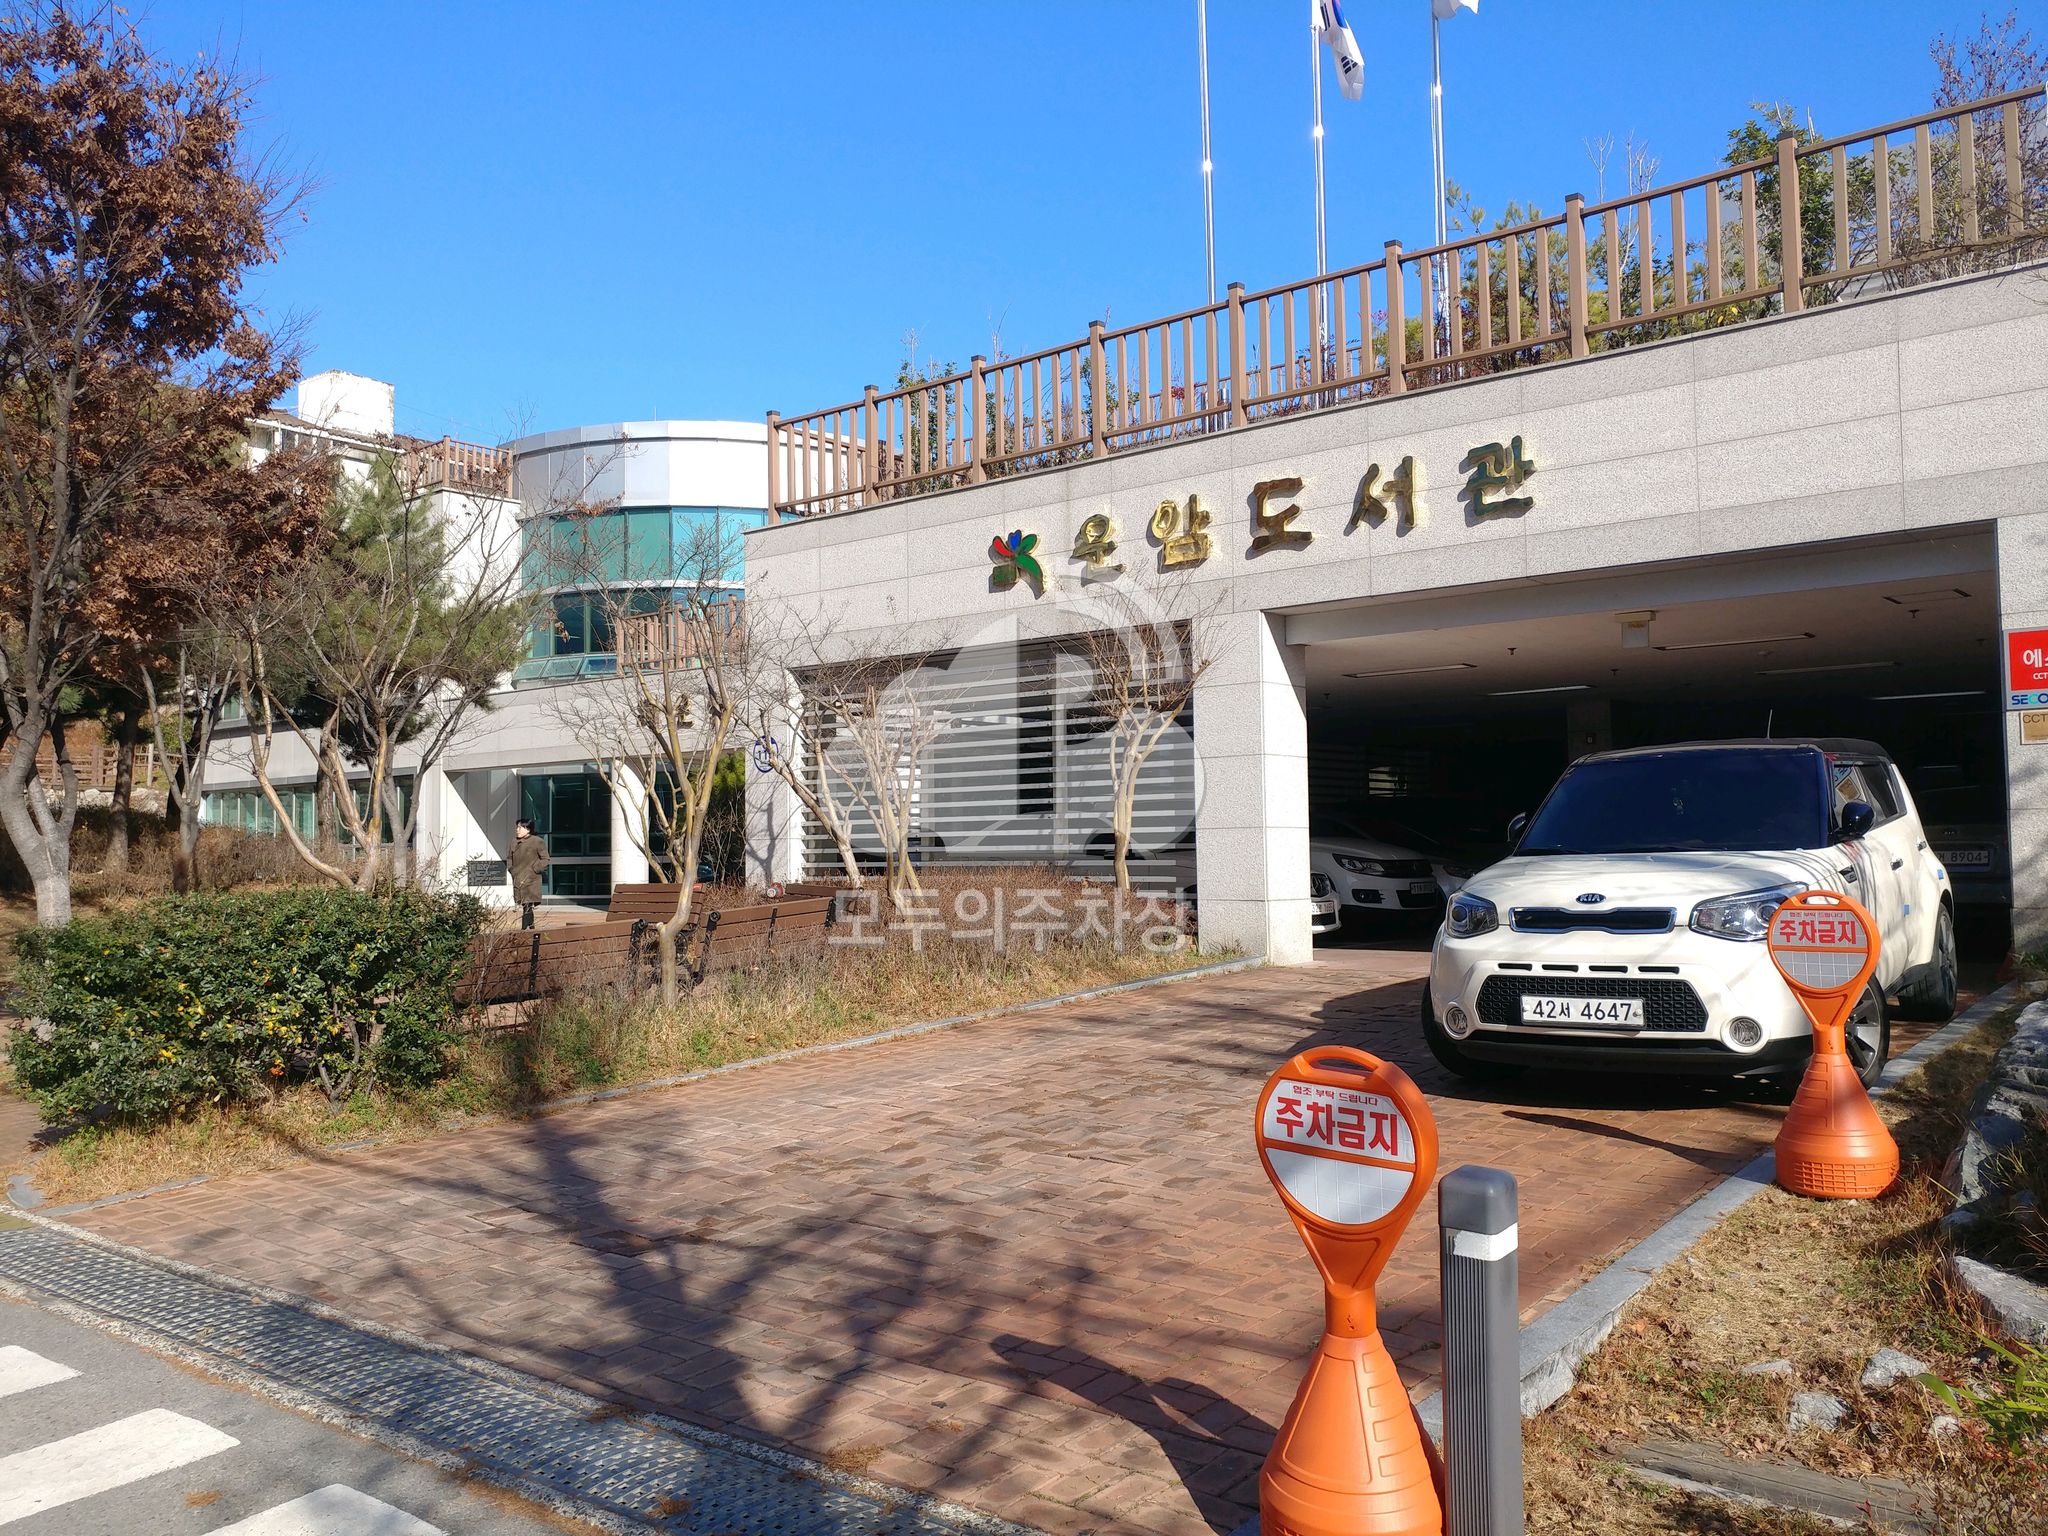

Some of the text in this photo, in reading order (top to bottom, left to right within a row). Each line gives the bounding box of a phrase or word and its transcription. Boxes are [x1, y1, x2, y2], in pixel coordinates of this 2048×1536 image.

[1579, 893, 1601, 902] KIA
[1779, 919, 1857, 944] 주차금지
[1533, 1000, 1632, 1021] 42서 4647
[1276, 1096, 1398, 1156] 주차금지
